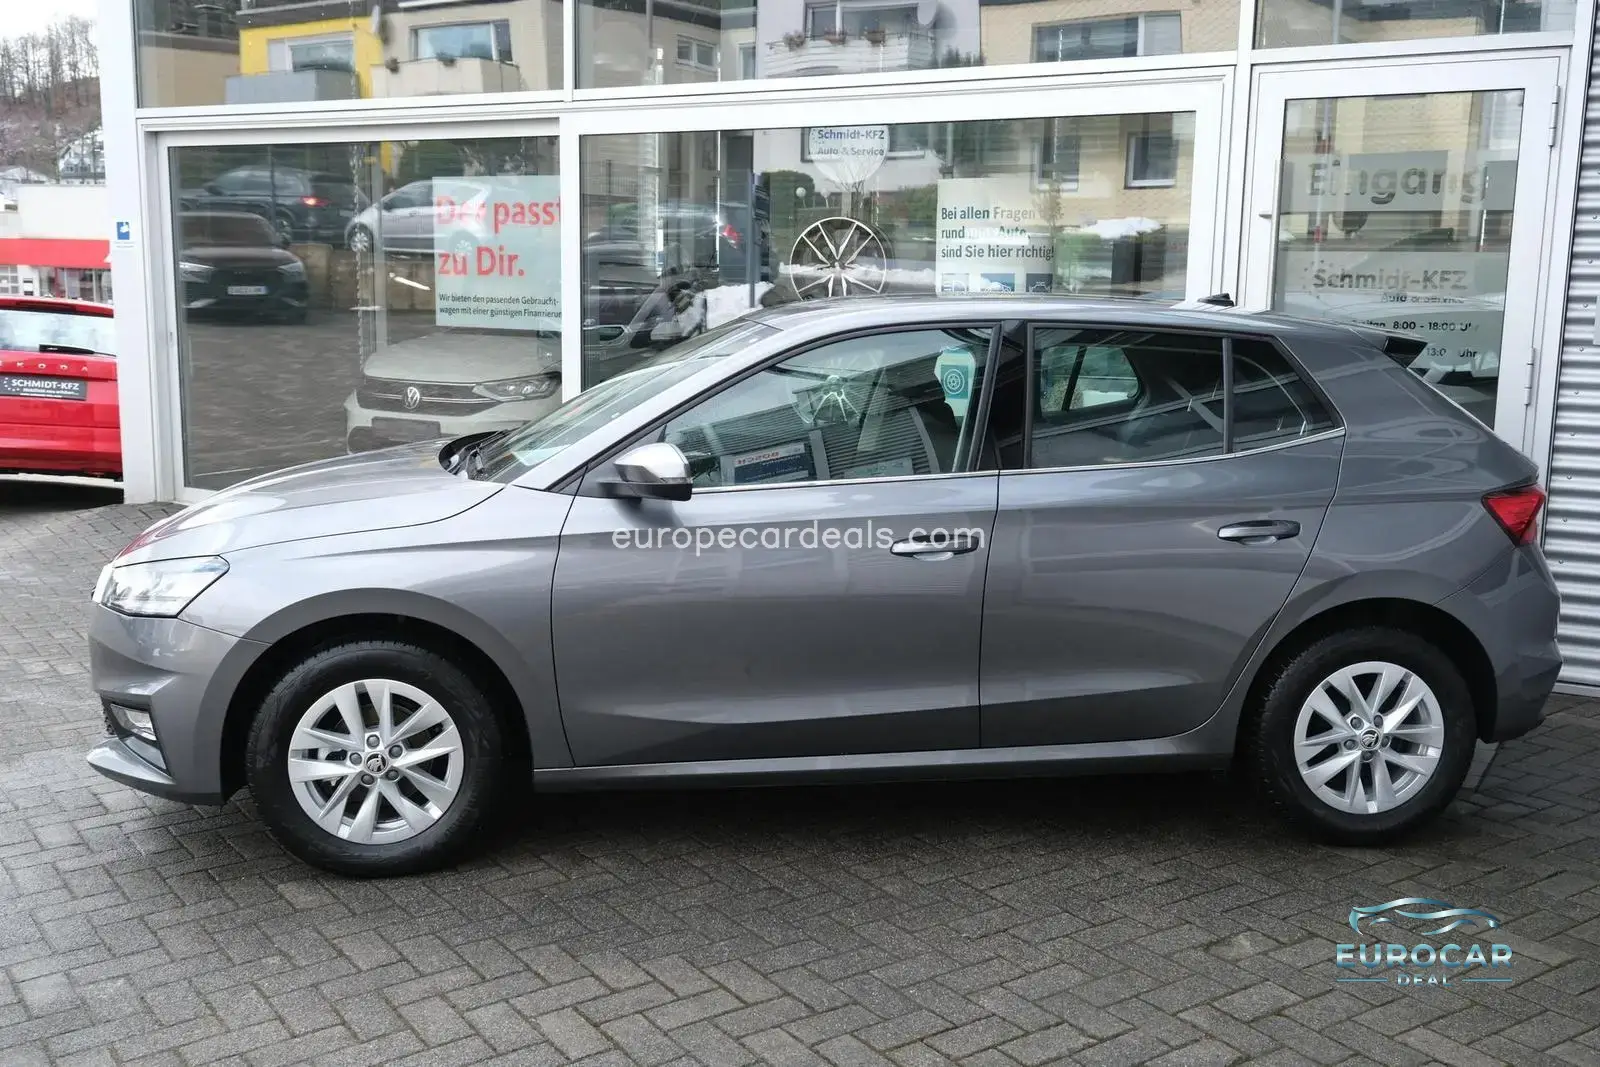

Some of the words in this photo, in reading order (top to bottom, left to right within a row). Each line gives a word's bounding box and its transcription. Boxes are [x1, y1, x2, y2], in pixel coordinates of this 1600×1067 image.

[818, 129, 885, 140] Schmidt-KFZ
[817, 147, 839, 155] Auto
[851, 147, 885, 156] Service
[941, 207, 957, 220] Bei
[960, 207, 989, 220] allen
[993, 206, 1035, 222] Fragen
[941, 226, 965, 239] rund
[941, 245, 962, 258] sind
[965, 245, 985, 258] Sie
[988, 245, 1013, 258] hier
[1016, 245, 1055, 261] richtig!
[438, 252, 468, 276] zu
[476, 245, 525, 277] Dir.
[439, 293, 451, 302] Wir
[451, 294, 471, 302] bieten
[472, 294, 485, 303] den
[486, 295, 521, 305] passenden
[439, 307, 460, 316] wagen
[461, 307, 472, 315] mit
[472, 307, 489, 316] einer
[490, 308, 522, 318] günstigen
[1393, 321, 1416, 330] 8:00
[1428, 321, 1456, 331] 18:00
[11, 378, 80, 391] SCHMIDT-KFZ
